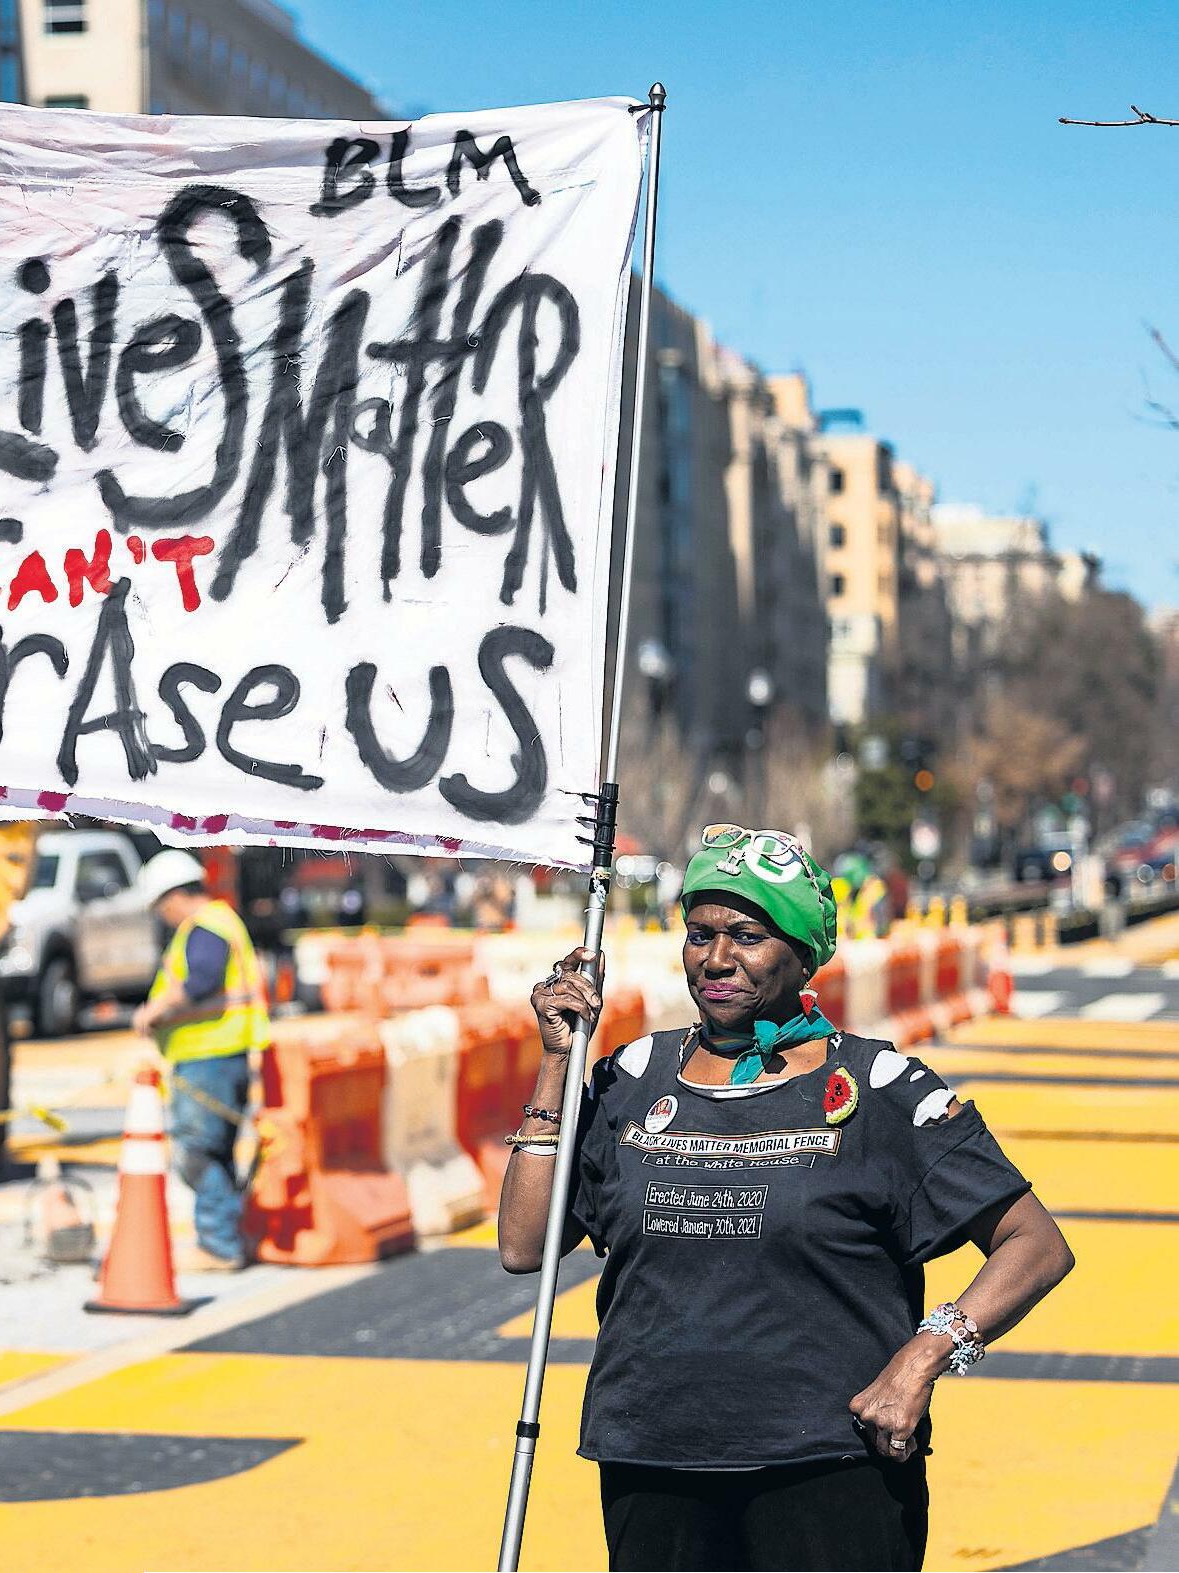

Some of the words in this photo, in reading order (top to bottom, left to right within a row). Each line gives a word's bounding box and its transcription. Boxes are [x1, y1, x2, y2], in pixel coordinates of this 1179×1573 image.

[307, 130, 541, 217] BLM
[632, 1131, 659, 1146] BLACK
[661, 1138, 688, 1151] LIVES
[689, 1139, 731, 1152] MATTER
[733, 1138, 791, 1153] MEMORIAL
[794, 1135, 830, 1147] FENCE
[655, 1156, 672, 1165] at
[675, 1155, 699, 1166] the
[649, 1186, 687, 1206] Erected
[687, 1190, 710, 1207] June
[737, 1190, 763, 1207] 2020
[647, 1213, 679, 1234] Lowered
[680, 1217, 714, 1239] January
[737, 1216, 757, 1234] 2021
